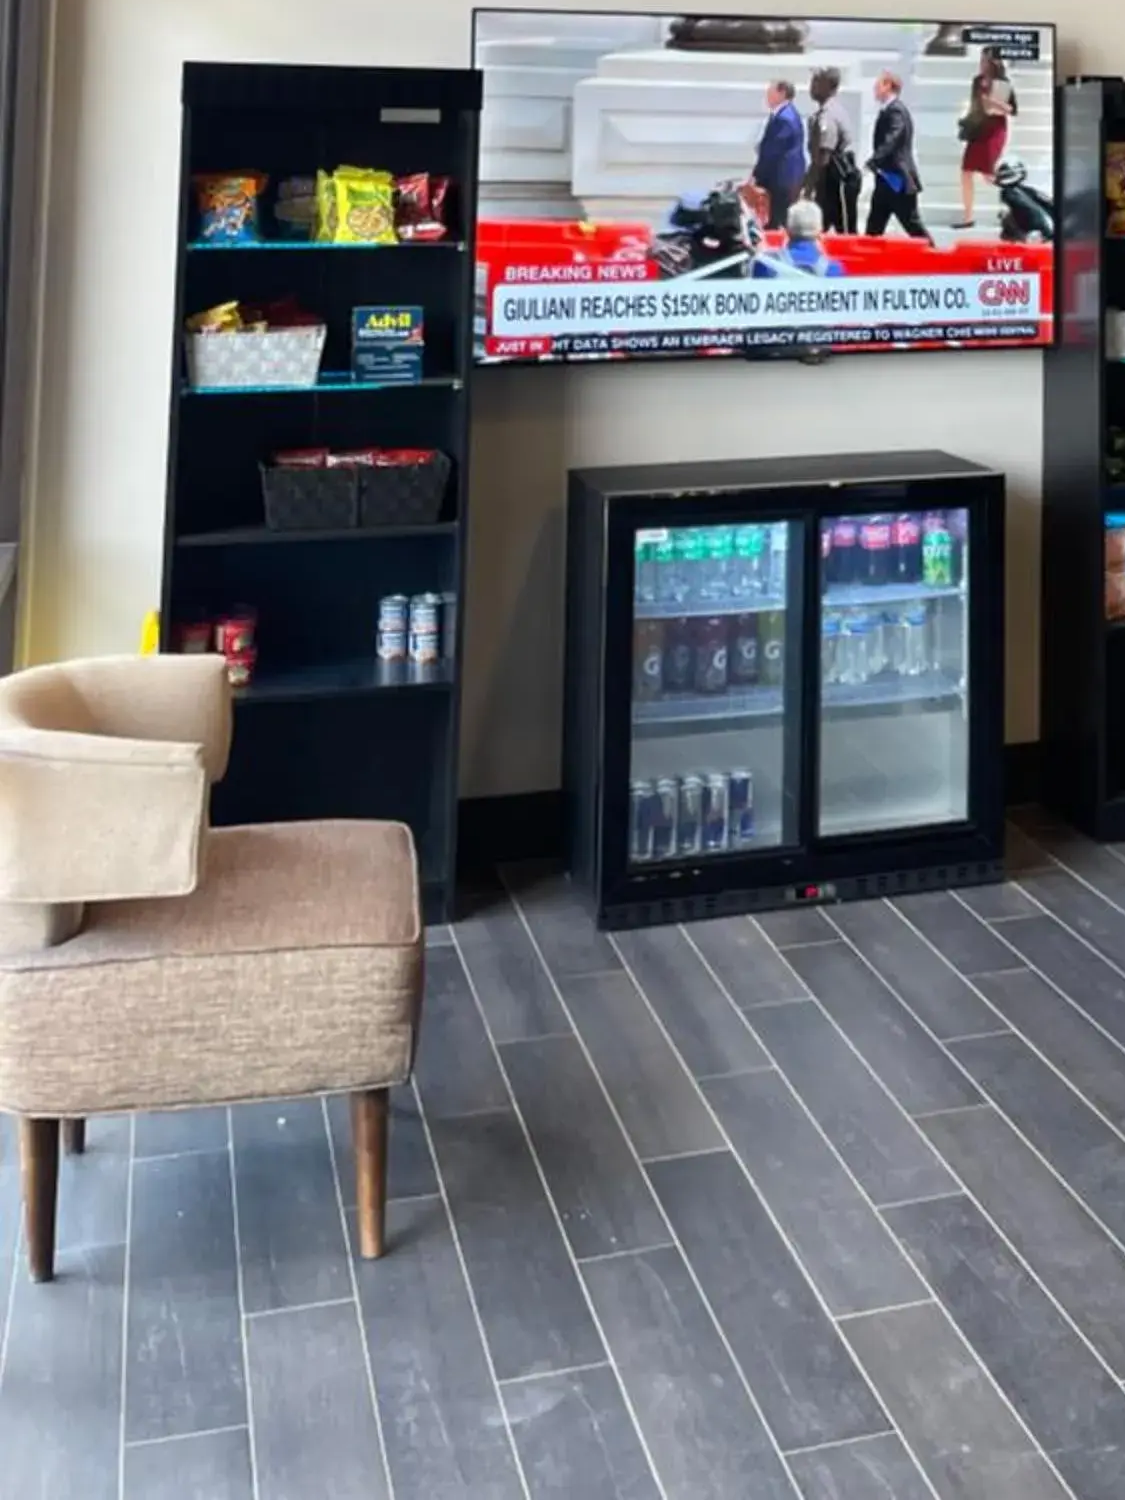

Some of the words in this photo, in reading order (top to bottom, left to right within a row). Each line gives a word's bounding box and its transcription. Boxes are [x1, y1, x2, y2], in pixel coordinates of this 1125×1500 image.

[504, 264, 592, 281] BREAKING
[597, 263, 648, 279] NEWS
[987, 257, 1023, 271] LIVE
[978, 278, 1031, 306] CNN
[503, 297, 576, 321] GIULIANI
[581, 294, 658, 319] REACHES
[661, 291, 712, 319] $150K
[715, 291, 760, 315] BOND
[764, 289, 860, 314] AGREEMENT
[863, 290, 879, 311] IN
[882, 287, 941, 311] FULTON
[944, 287, 970, 309] CO.
[364, 311, 412, 328] Advil
[496, 340, 527, 354] JUST
[529, 340, 544, 352] IN
[573, 337, 608, 350] DATA
[612, 335, 658, 349] SHOWS
[661, 336, 679, 348] AN
[683, 333, 744, 347] EMBRAER
[747, 331, 794, 345] LEGACY
[797, 328, 871, 344] REGISTERED
[875, 329, 890, 341] TO
[893, 327, 945, 340] WAGNER
